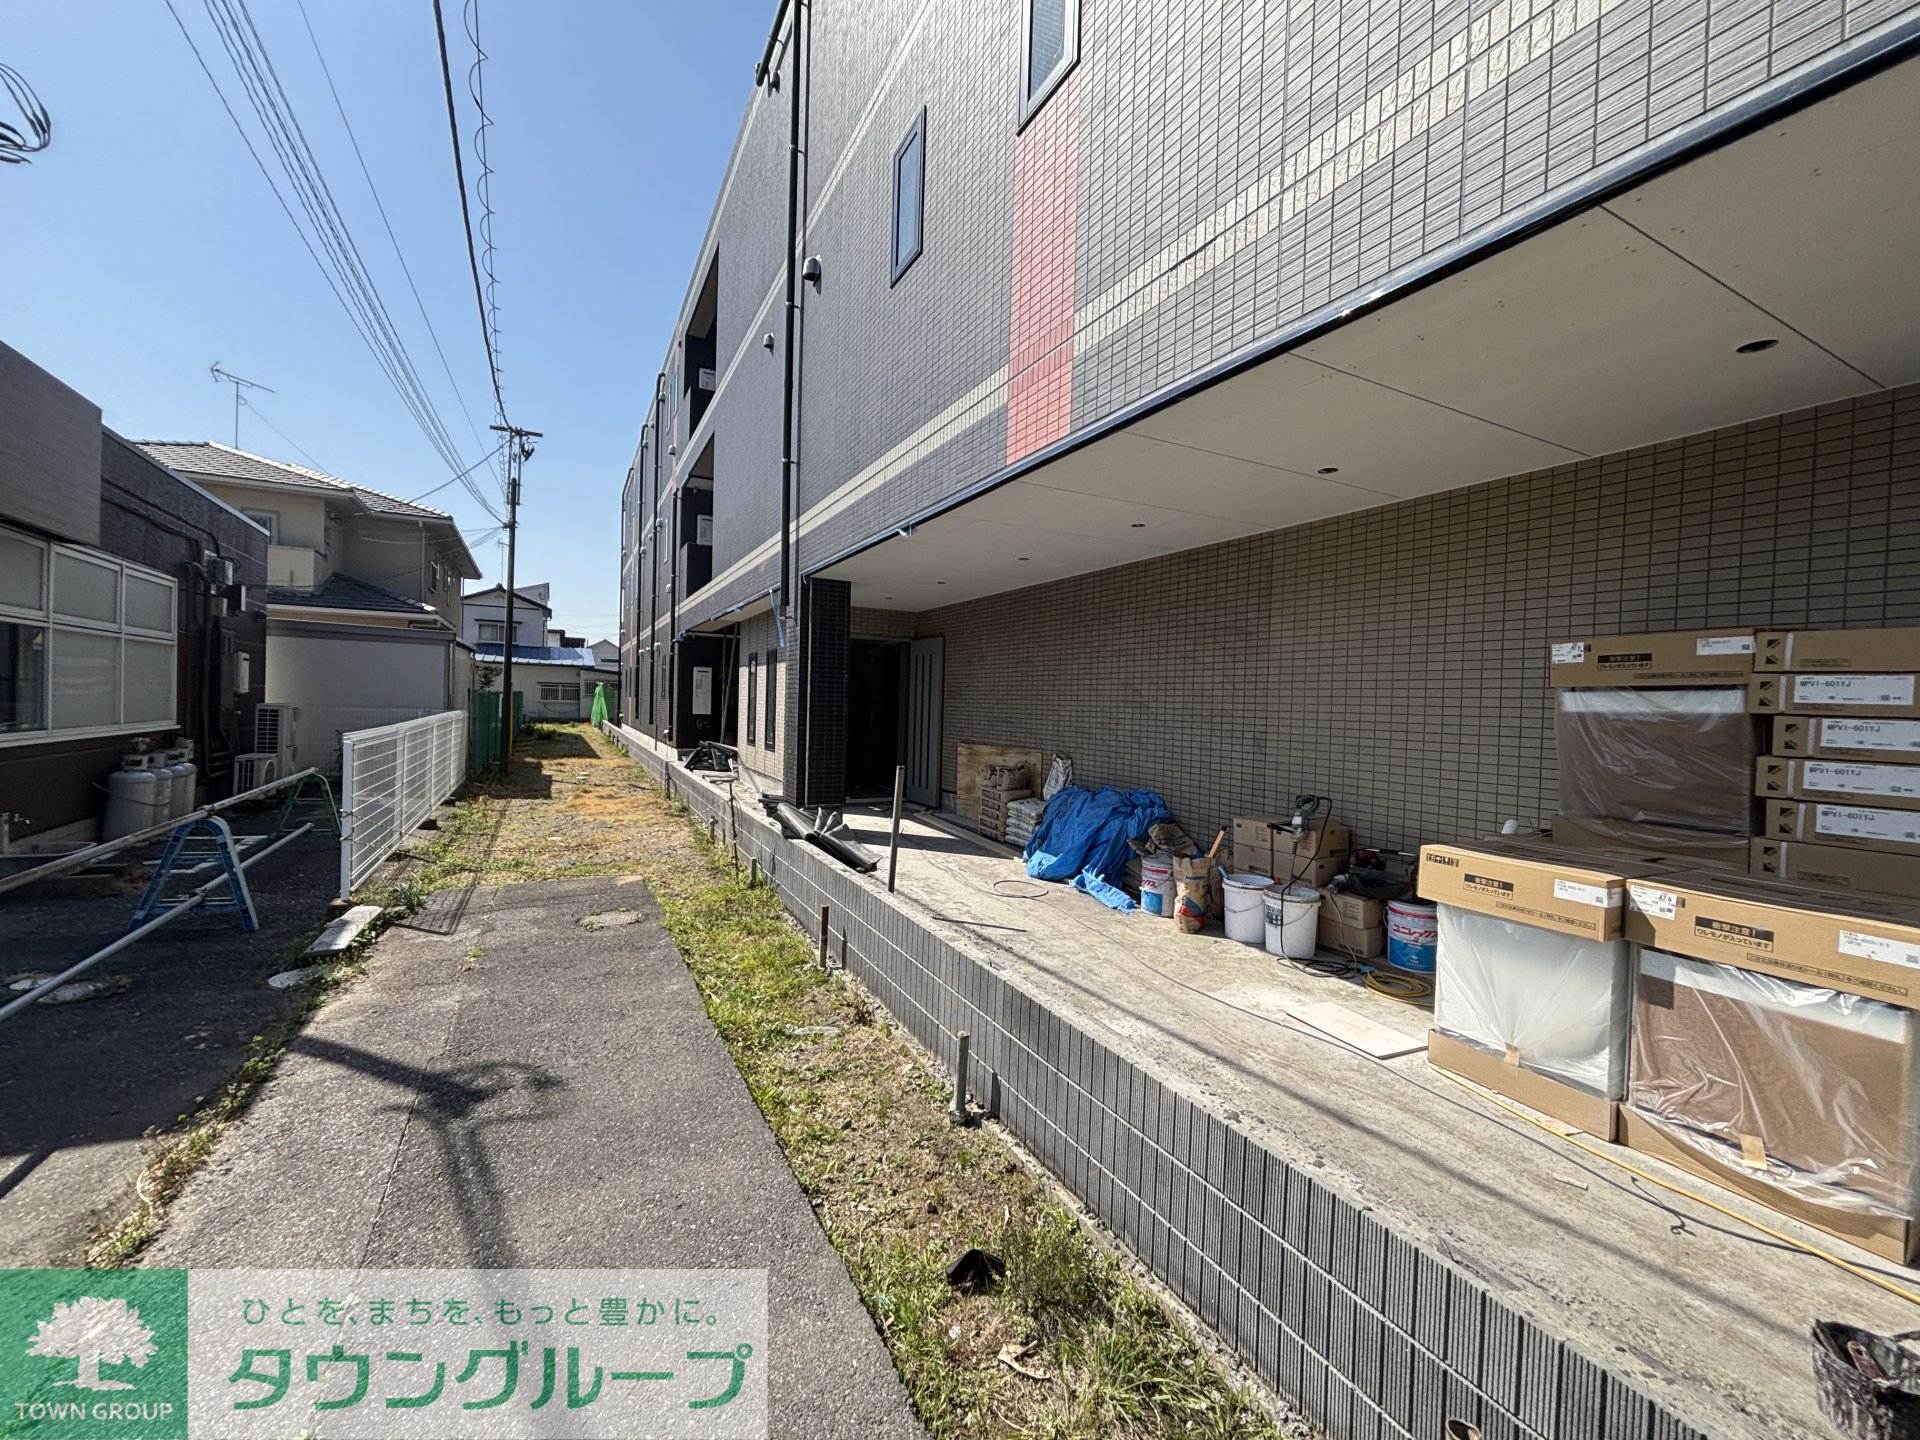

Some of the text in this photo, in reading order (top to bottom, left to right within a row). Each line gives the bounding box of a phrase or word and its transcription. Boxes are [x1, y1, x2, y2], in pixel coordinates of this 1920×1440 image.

[1800, 680, 1851, 688] MPV1-601YJ
[1827, 724, 1880, 732] MPV1-601YJ
[1809, 767, 1861, 776] MPV1-601YJ
[1696, 928, 1771, 949] ワレモノが入っています
